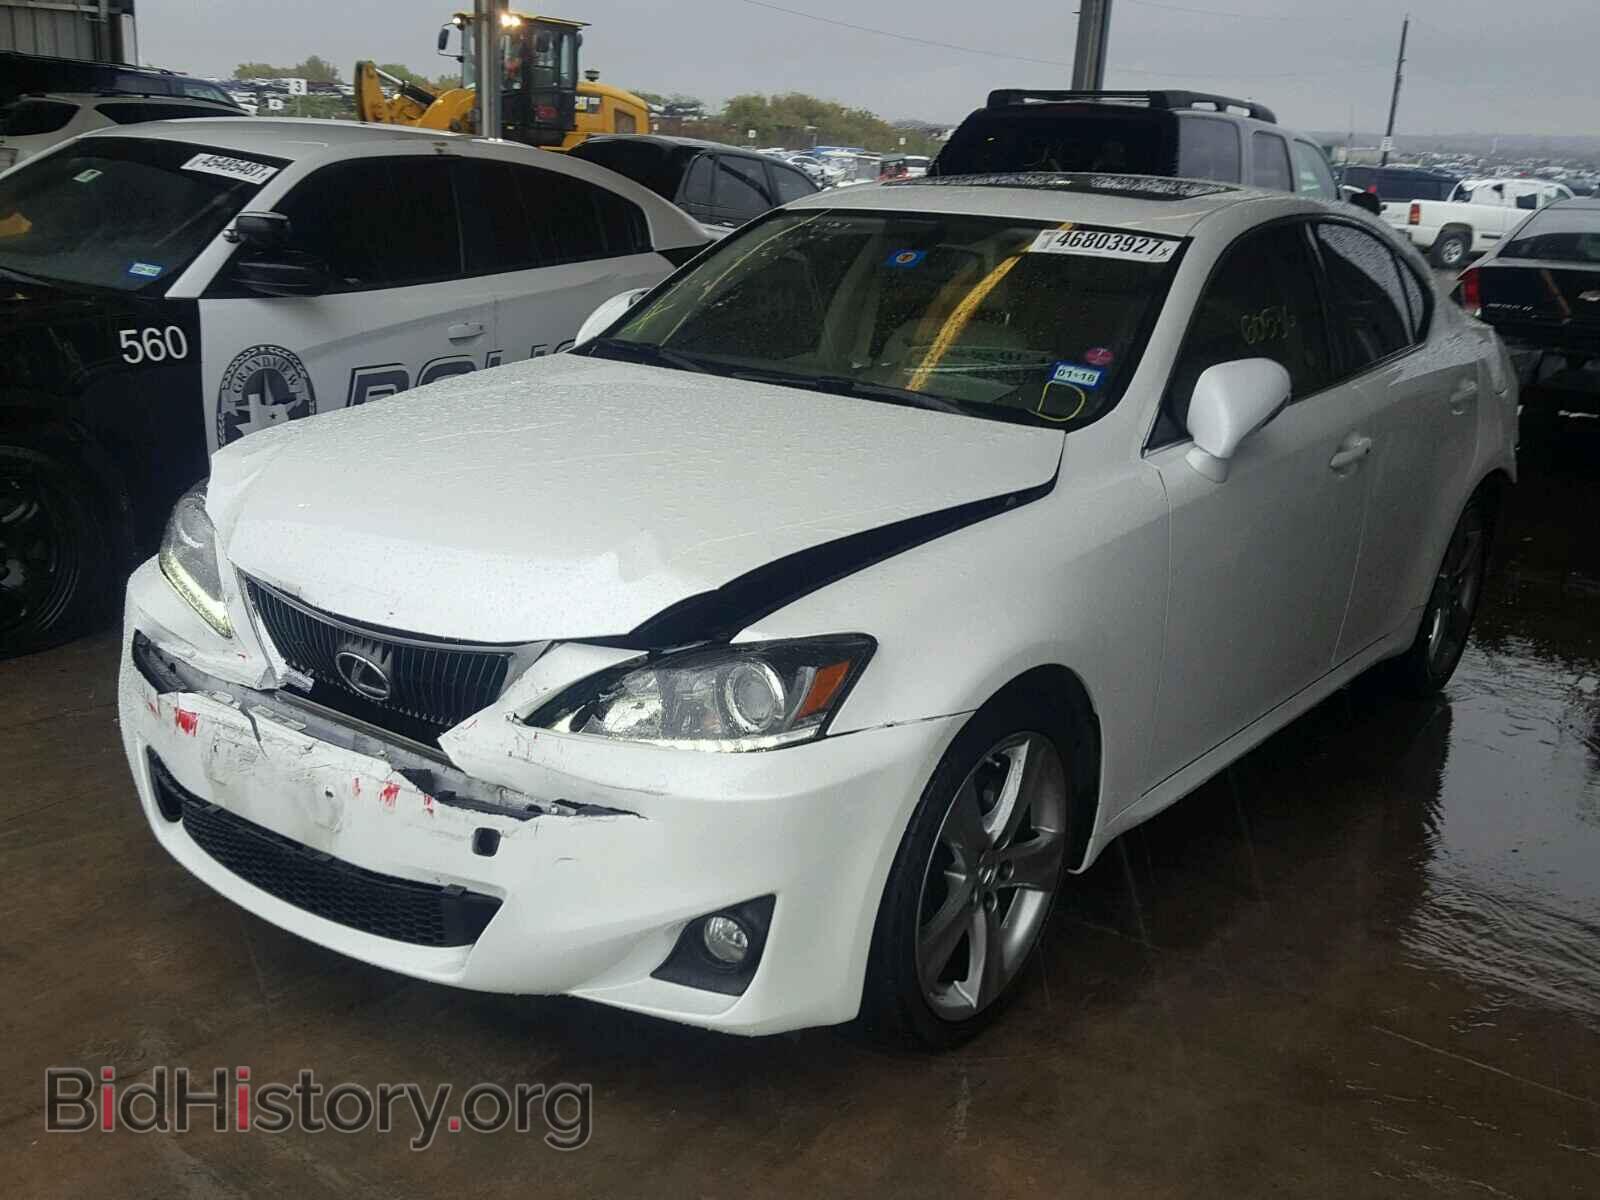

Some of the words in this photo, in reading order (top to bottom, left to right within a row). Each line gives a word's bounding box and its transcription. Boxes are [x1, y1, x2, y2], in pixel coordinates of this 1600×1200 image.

[1056, 231, 1164, 255] 46803927
[119, 325, 188, 364] 560
[231, 356, 300, 394] GRANDVIEW
